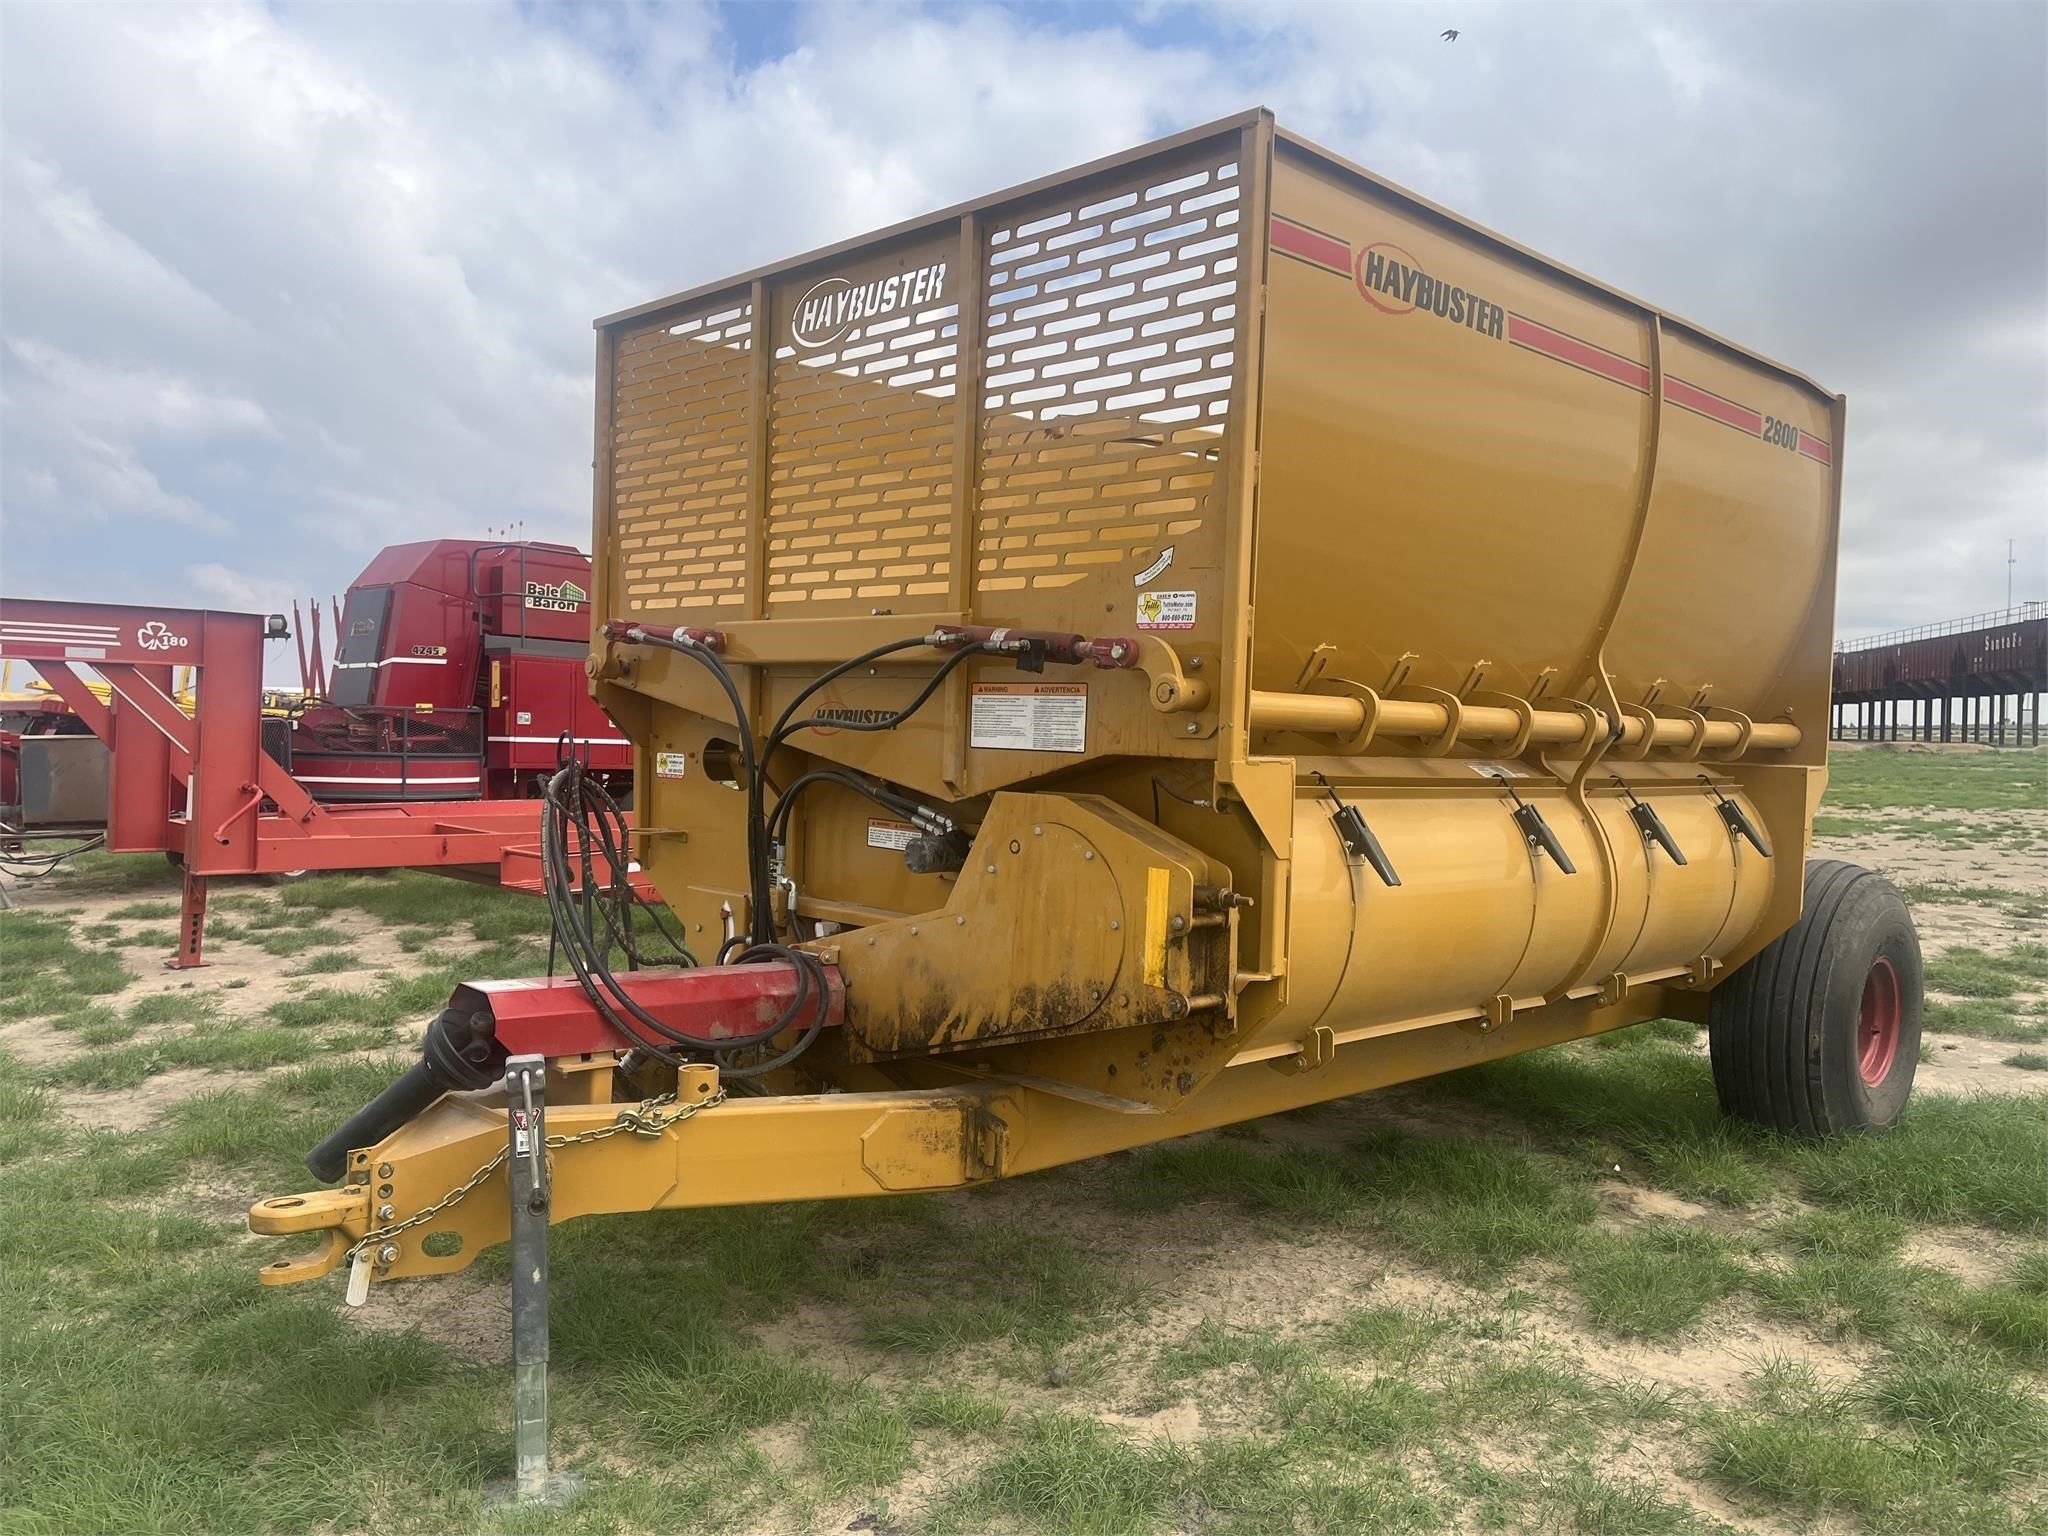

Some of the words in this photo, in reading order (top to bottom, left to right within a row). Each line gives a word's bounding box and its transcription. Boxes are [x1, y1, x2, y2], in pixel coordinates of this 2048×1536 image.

[800, 263, 946, 334] HAYBUSTER
[1365, 251, 1504, 340] HAYBUSTER
[1763, 415, 1798, 451] 2800
[527, 583, 559, 597] Bale
[532, 597, 576, 611] Baron
[1145, 601, 1160, 611] Tuttle
[162, 636, 188, 647] 180
[1985, 635, 2011, 651] Santa
[1040, 686, 1081, 694] ADVERTENCIA
